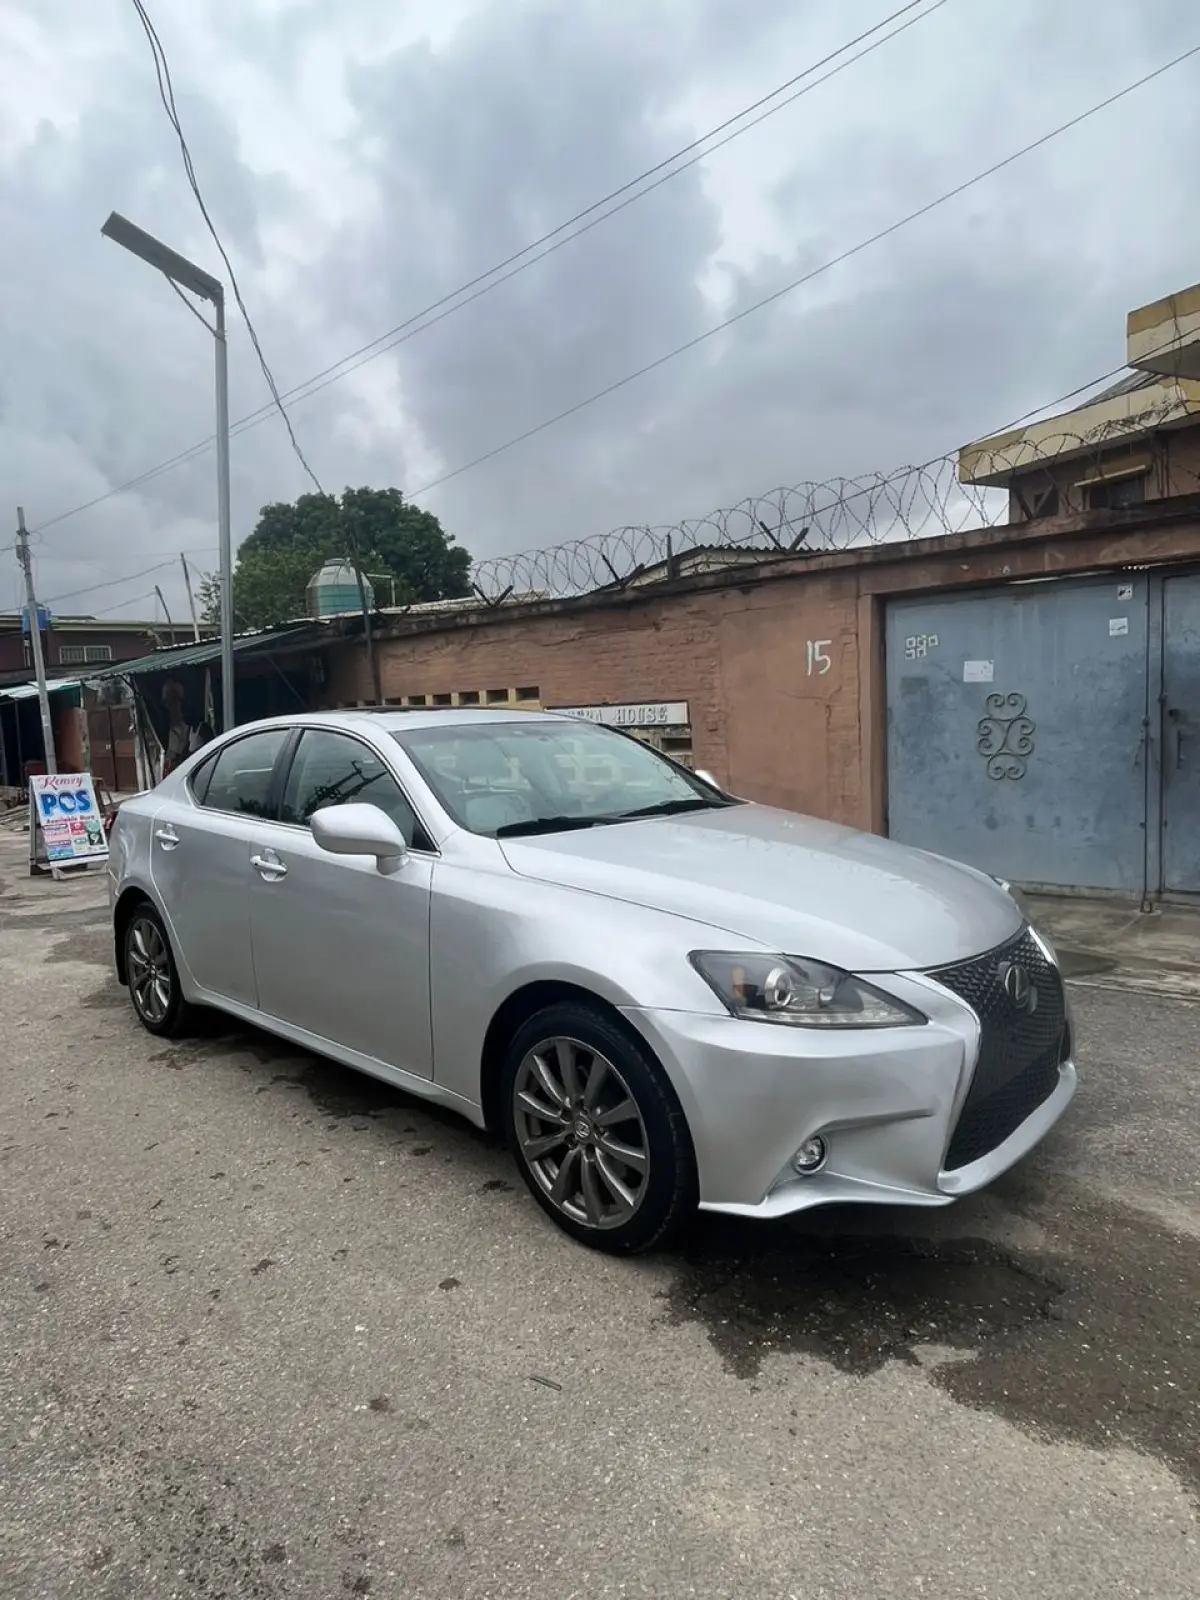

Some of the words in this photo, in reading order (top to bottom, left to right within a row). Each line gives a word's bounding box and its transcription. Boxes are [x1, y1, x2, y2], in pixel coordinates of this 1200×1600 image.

[806, 639, 832, 676] 15
[615, 704, 668, 724] HOUSE
[40, 789, 91, 815] POS
